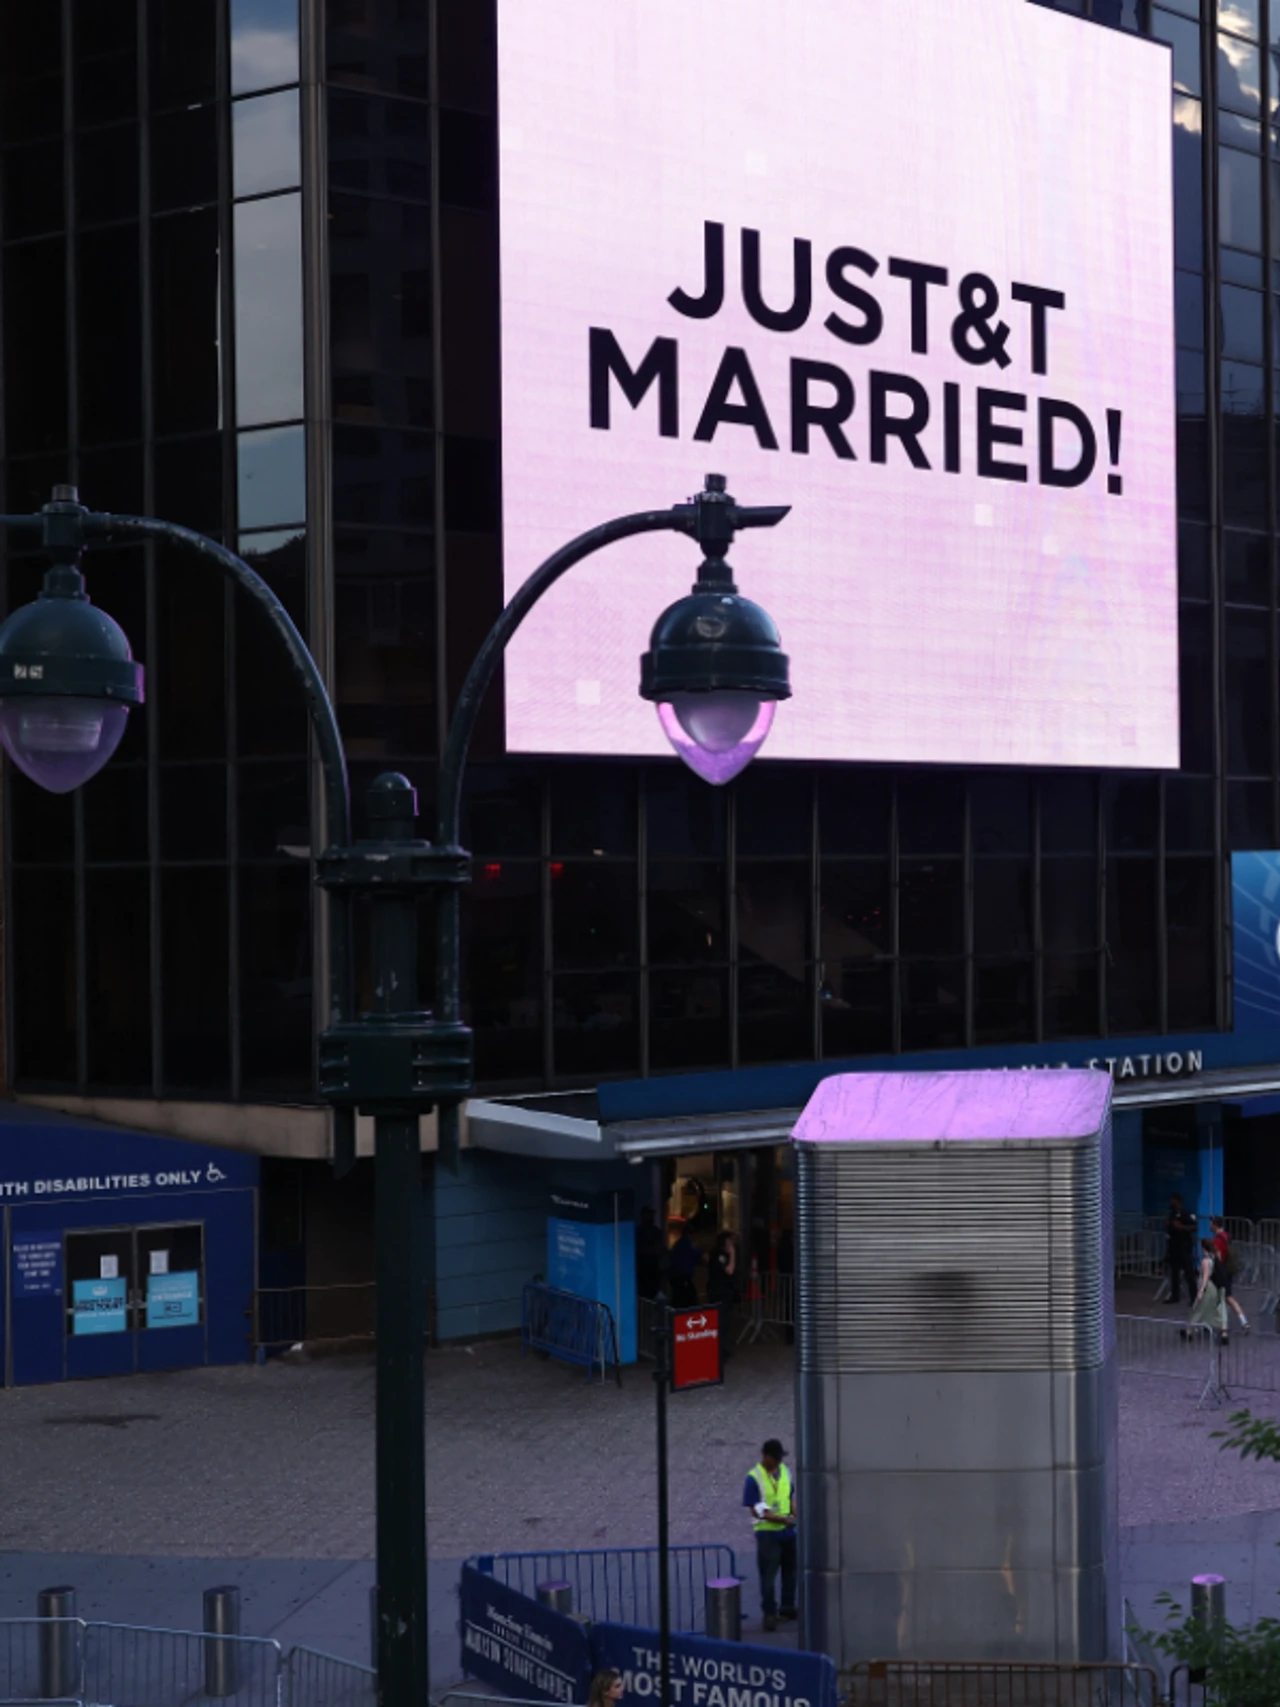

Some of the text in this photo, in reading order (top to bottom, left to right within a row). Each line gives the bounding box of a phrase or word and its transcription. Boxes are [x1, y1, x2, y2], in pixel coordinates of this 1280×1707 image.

[666, 220, 1065, 376] JUST&T
[588, 326, 1123, 496] MARRIED!
[1088, 1050, 1202, 1078] STATION
[34, 1173, 151, 1194] DISABILITIES
[155, 1170, 201, 1186] ONLY
[631, 1646, 787, 1691] THE WORLD'S
